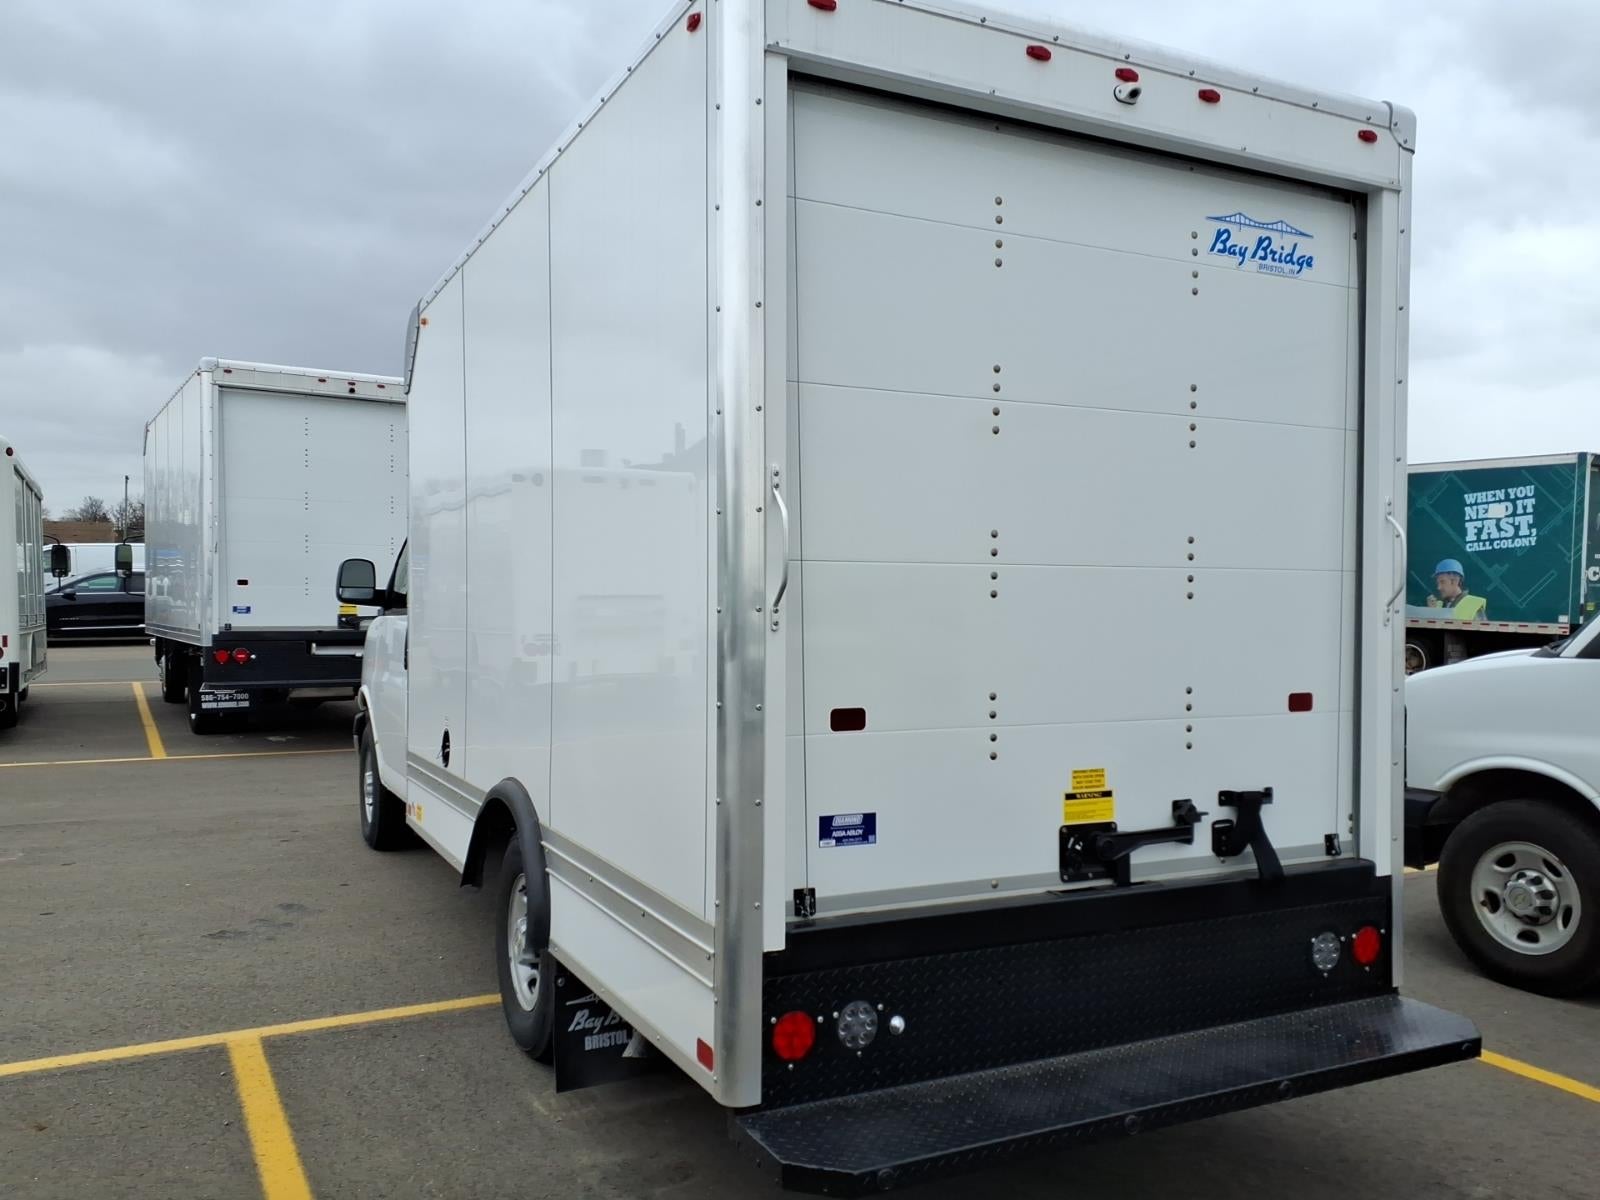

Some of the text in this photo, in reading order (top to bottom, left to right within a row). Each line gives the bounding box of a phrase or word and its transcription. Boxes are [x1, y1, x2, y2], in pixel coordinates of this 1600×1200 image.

[1209, 228, 1314, 274] Bay Bridge
[1464, 485, 1535, 505] WHEN YOU
[1464, 498, 1536, 520] NED IT
[1464, 514, 1537, 542] FAST,
[1466, 536, 1537, 552] CALL COLONY
[567, 1008, 605, 1034] Bay
